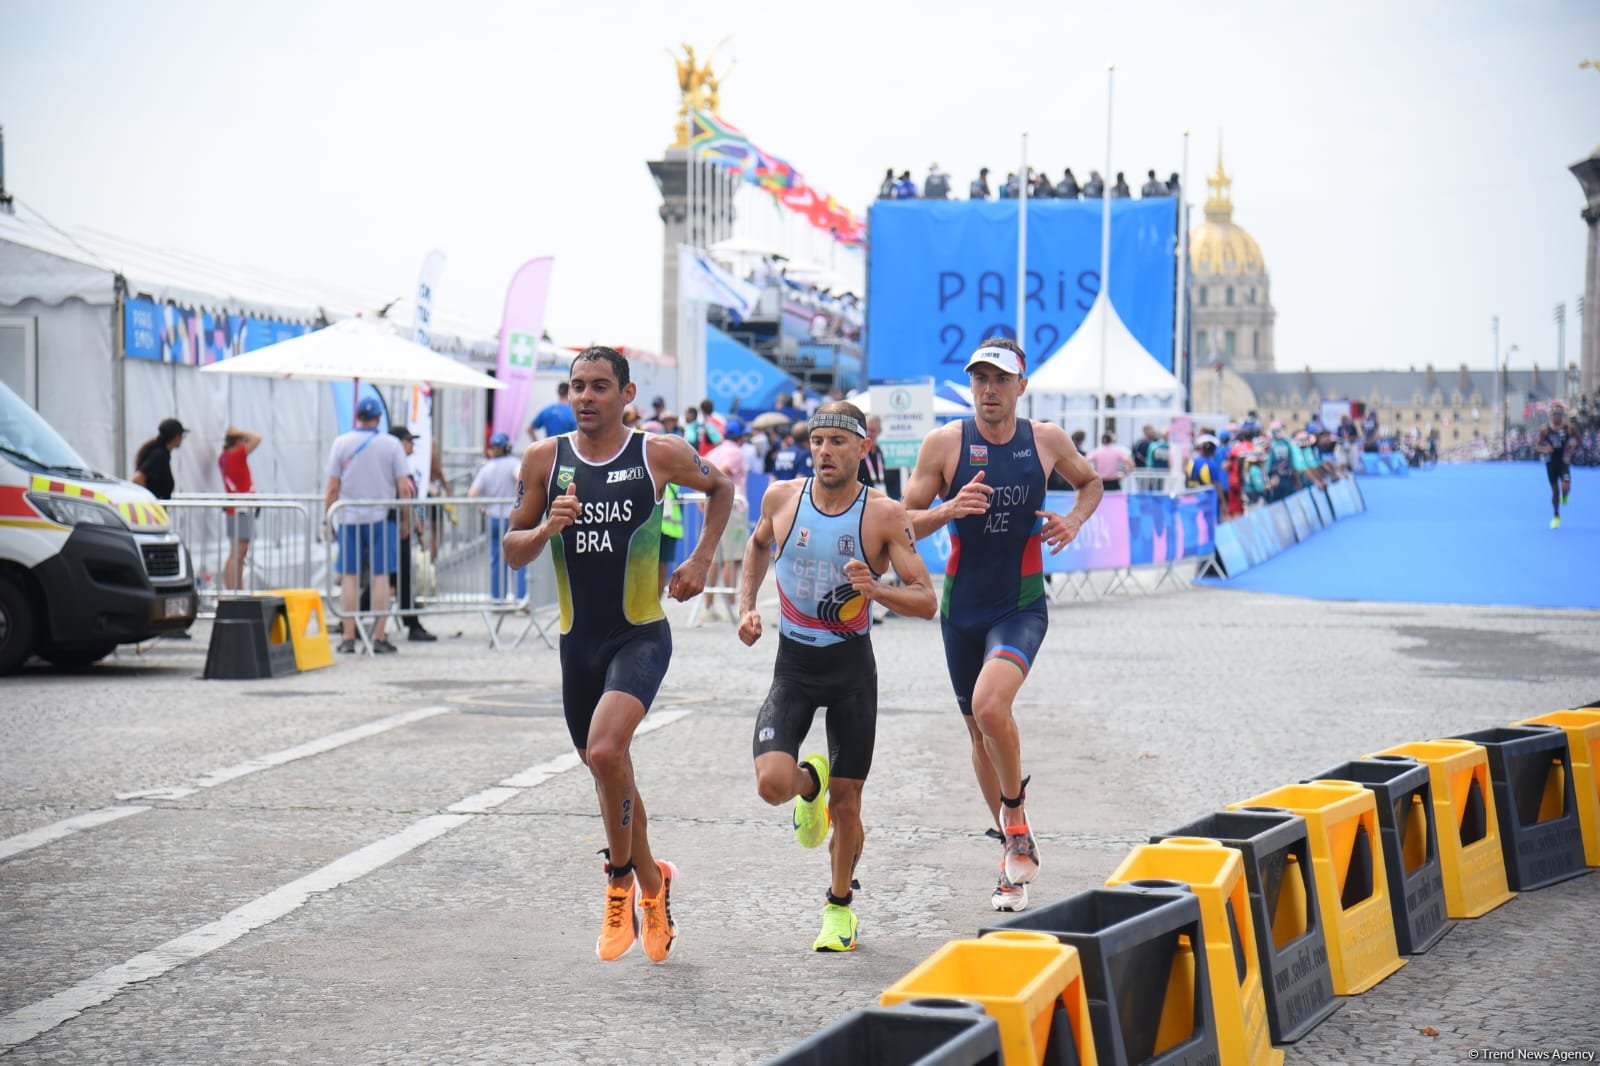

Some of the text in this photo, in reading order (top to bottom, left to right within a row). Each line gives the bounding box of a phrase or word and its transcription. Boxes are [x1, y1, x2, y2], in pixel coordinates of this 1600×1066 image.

[988, 485, 1030, 507] VTSOV
[574, 499, 633, 525] ESSIAS
[983, 512, 1010, 535] AZE
[576, 530, 614, 553] BRA
[793, 558, 848, 583] GEEN
[796, 579, 845, 604] BEL
